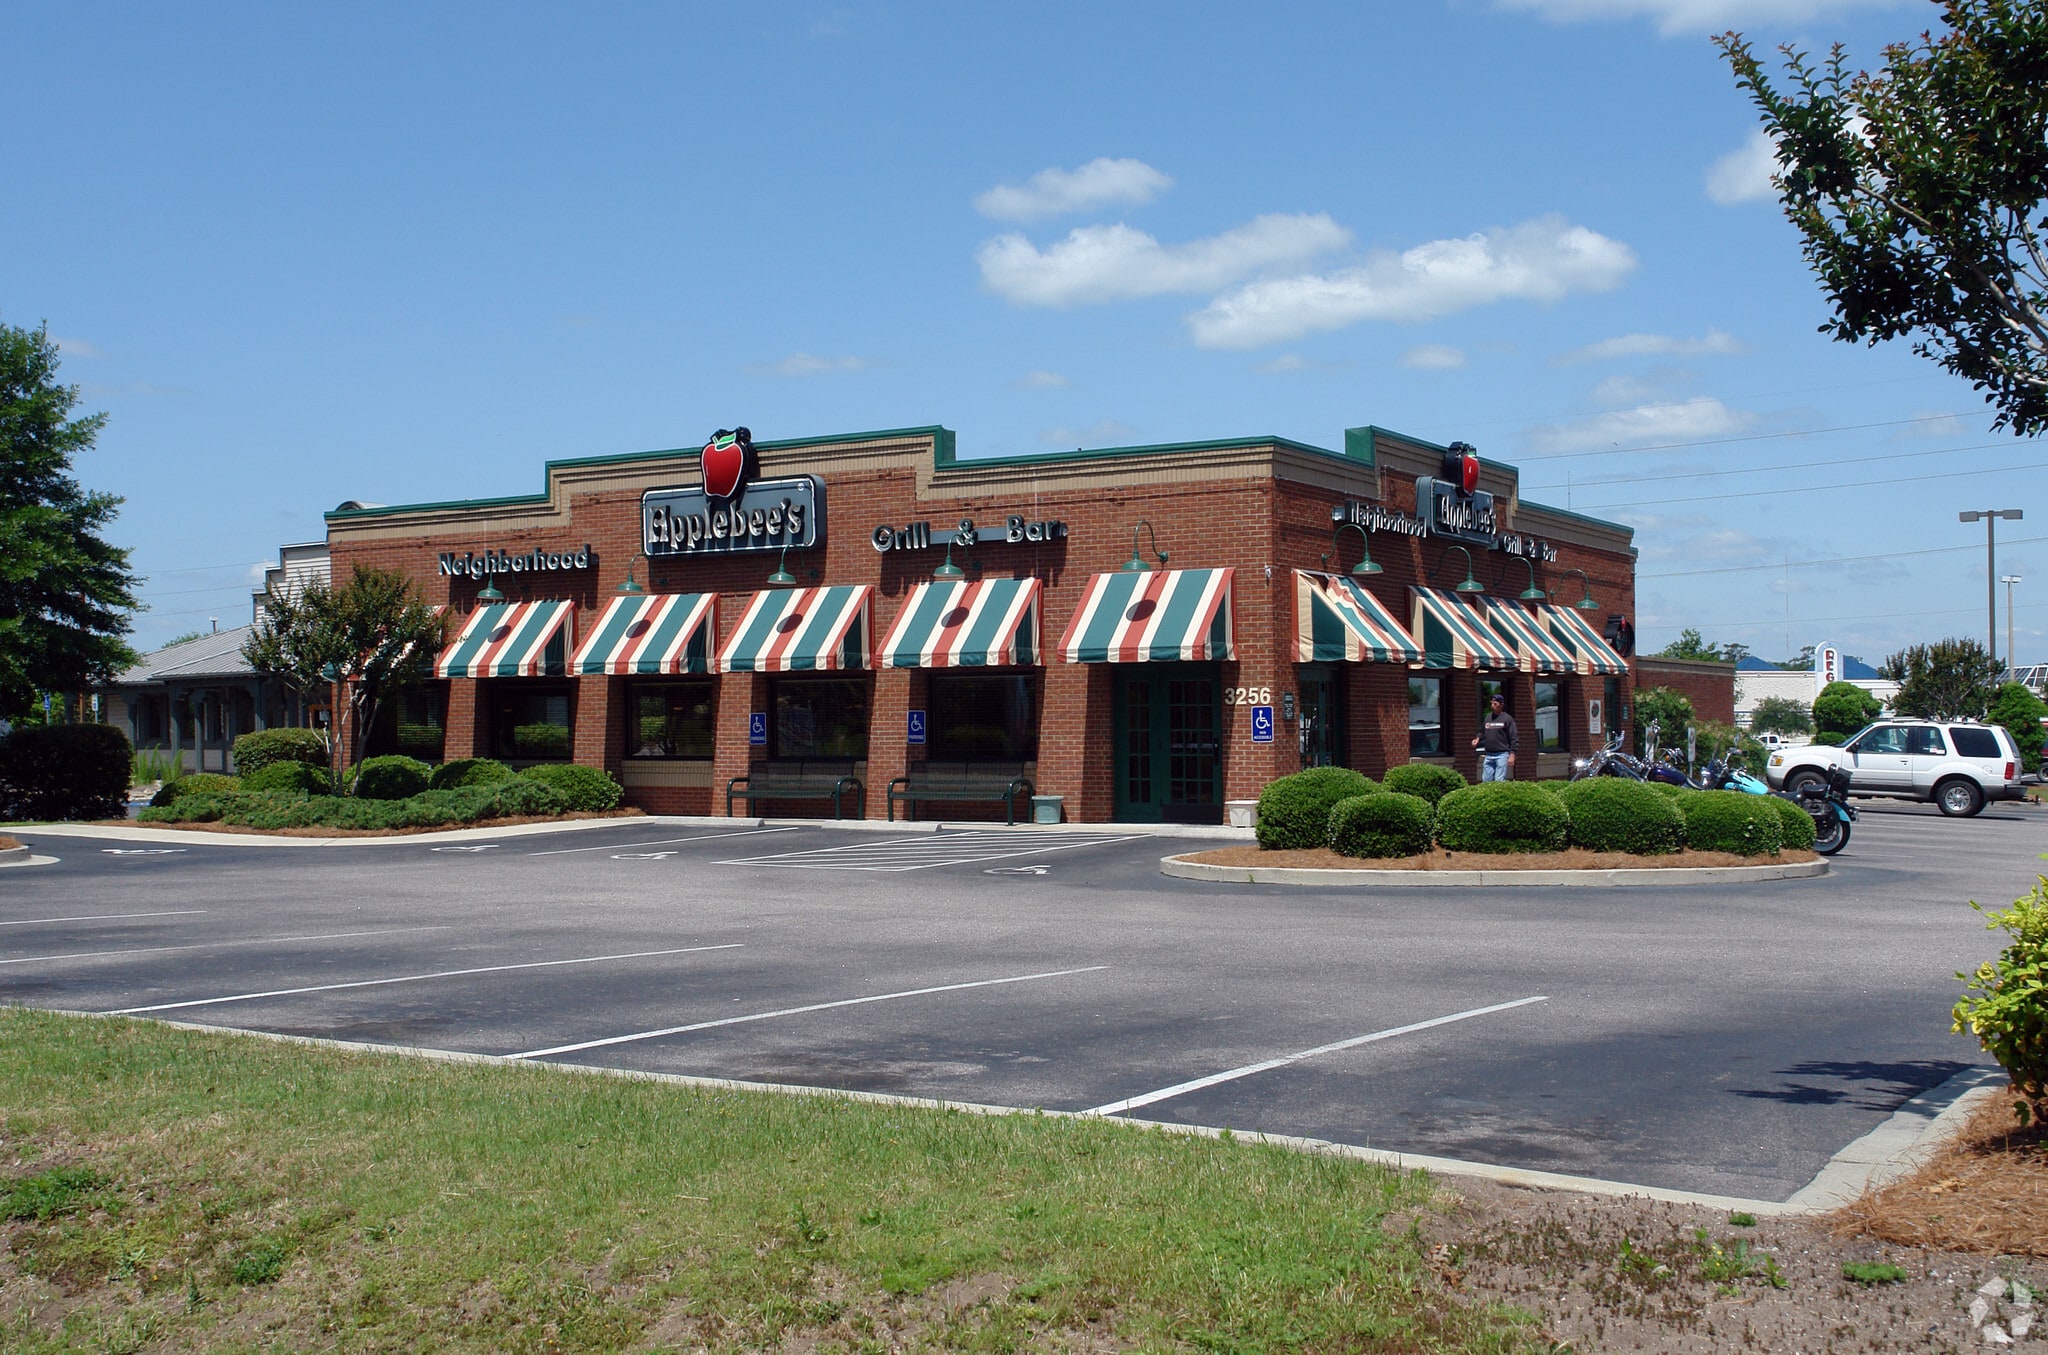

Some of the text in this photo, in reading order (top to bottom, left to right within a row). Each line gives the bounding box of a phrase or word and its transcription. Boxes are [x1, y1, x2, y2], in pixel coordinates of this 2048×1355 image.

[648, 498, 804, 550] Applebee's
[872, 514, 1061, 552] Grill & Bar
[1350, 501, 1427, 538] Neighborhood
[1441, 495, 1497, 535] Applebee's
[438, 544, 591, 581] Neighborhood
[1503, 535, 1522, 555] Grill
[1224, 687, 1271, 705] 3256
